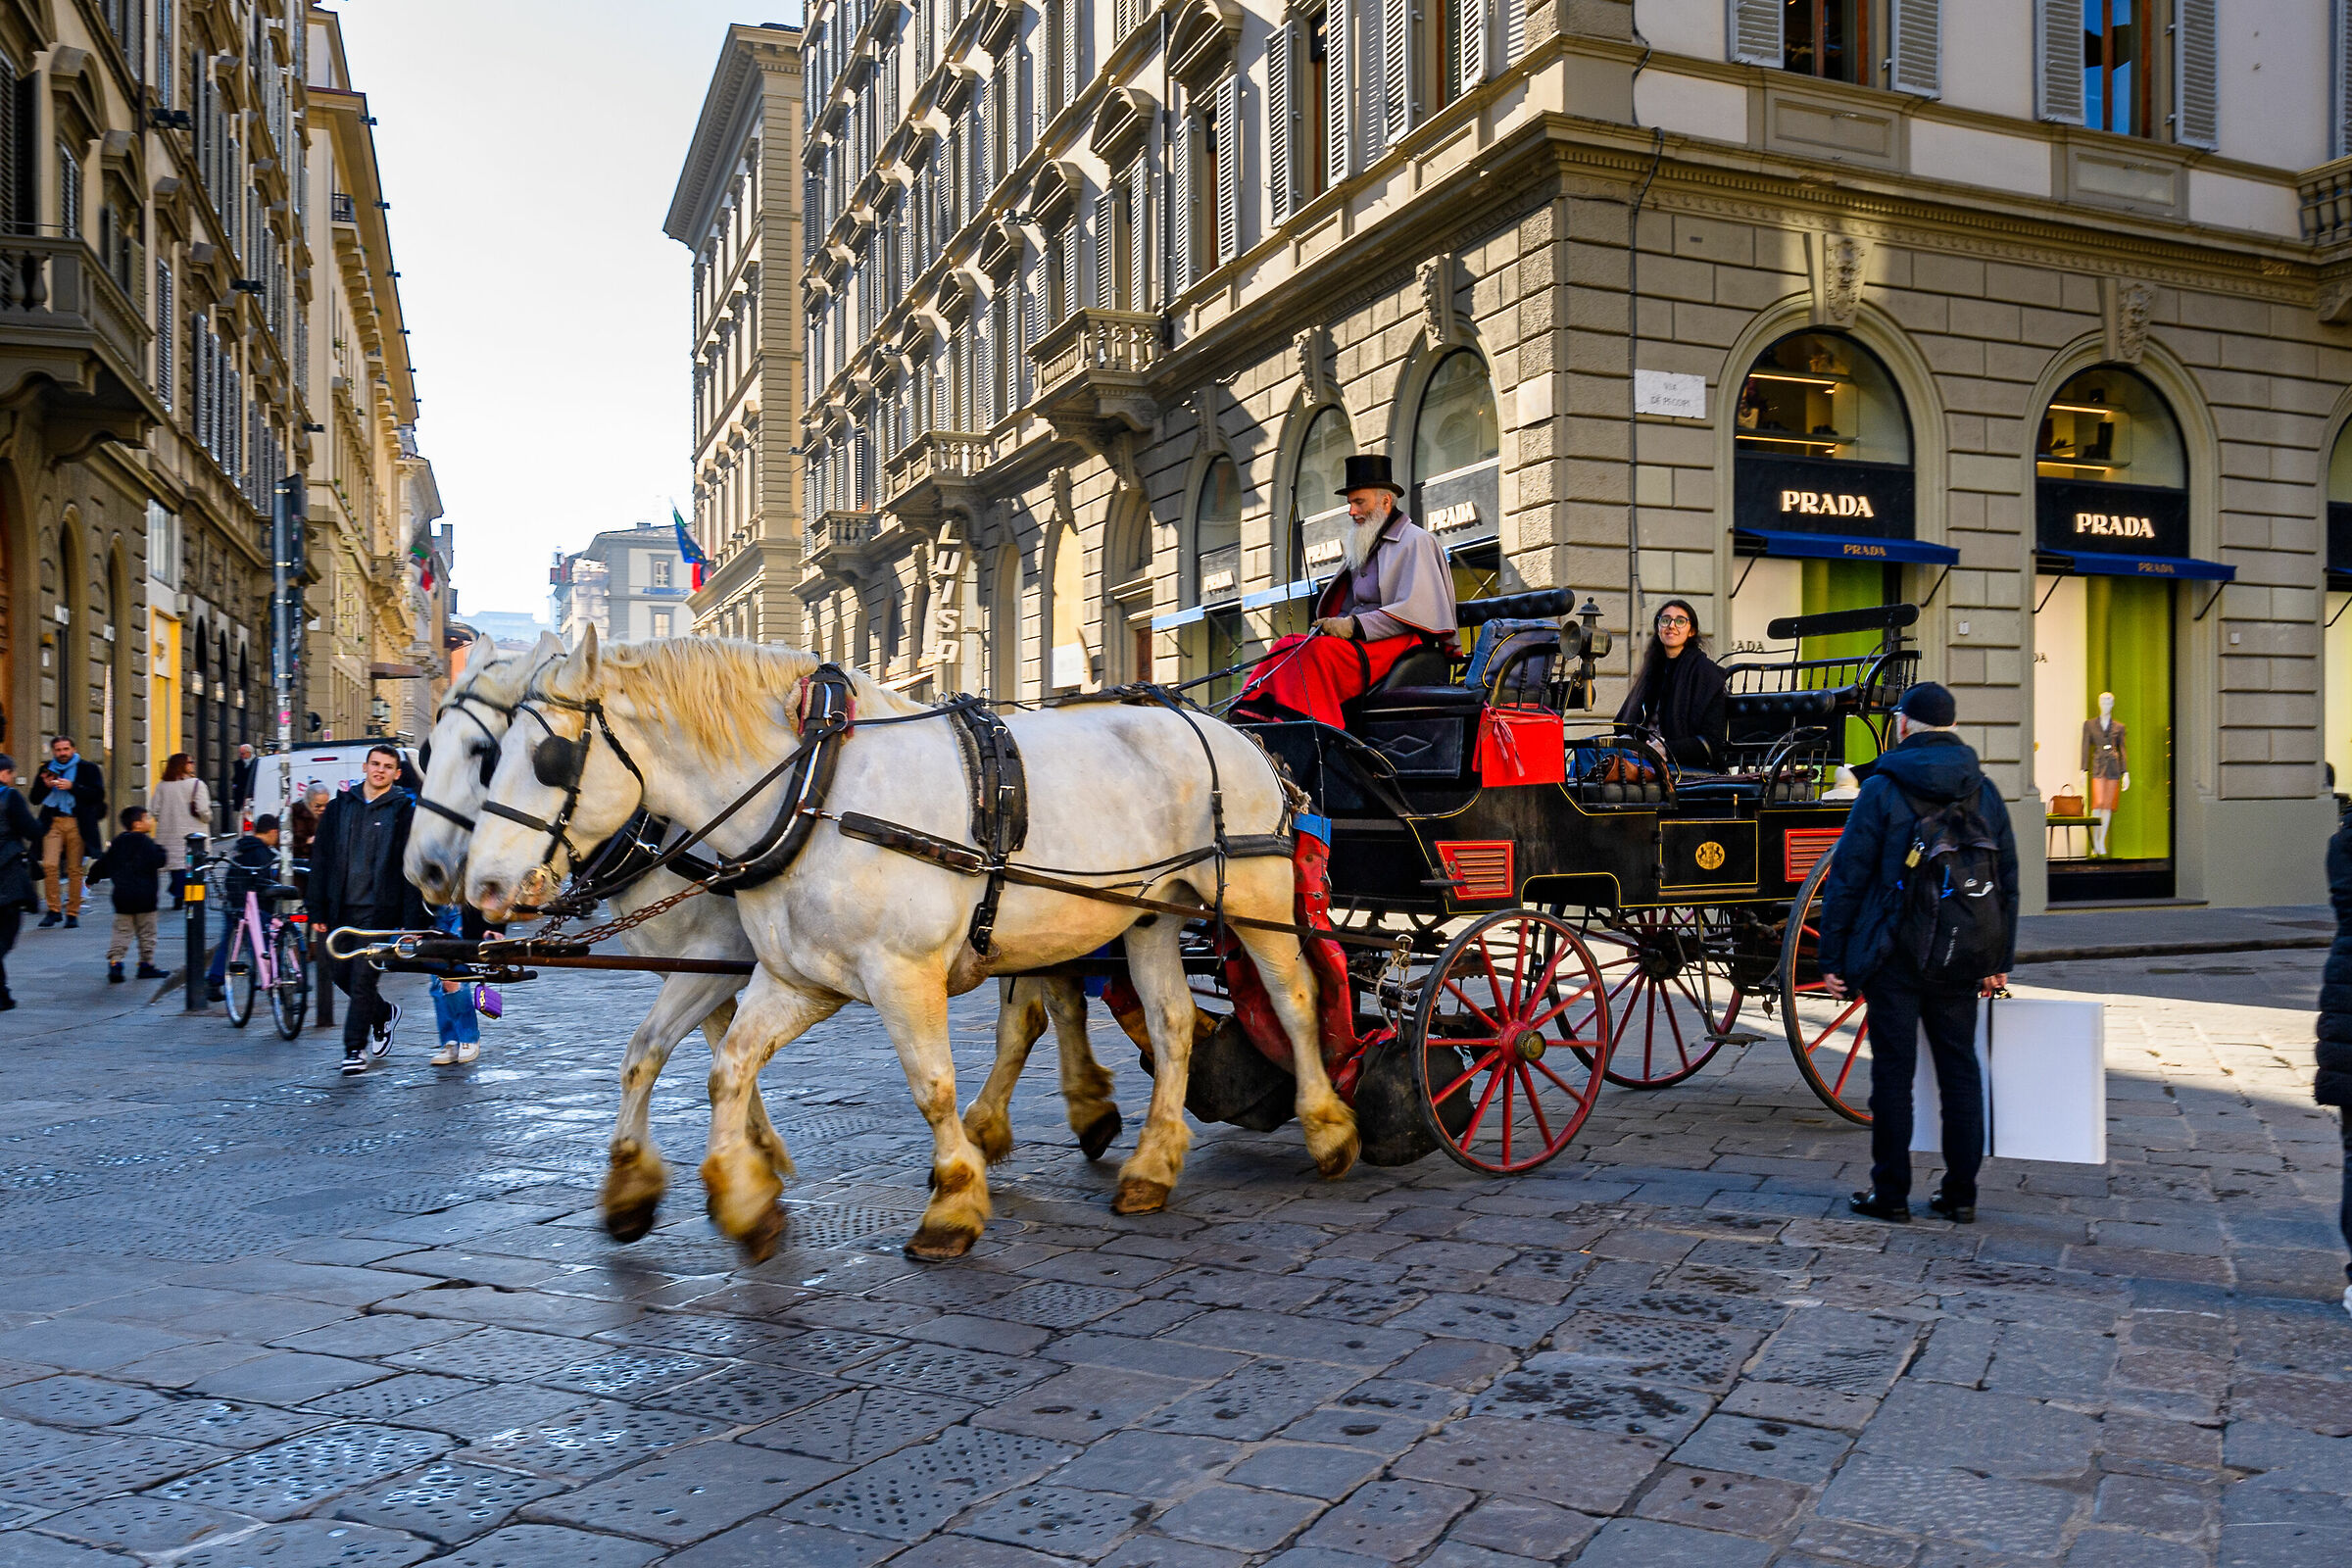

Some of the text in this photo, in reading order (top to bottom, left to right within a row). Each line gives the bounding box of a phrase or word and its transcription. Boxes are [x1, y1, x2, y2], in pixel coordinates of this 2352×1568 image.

[1782, 490, 1875, 517] PRADA
[1427, 501, 1477, 532] PRADA
[2076, 514, 2155, 538] PRADA
[1843, 544, 1887, 557] PRADA
[2138, 562, 2175, 574] PRADA
[936, 520, 962, 663] LUISA
